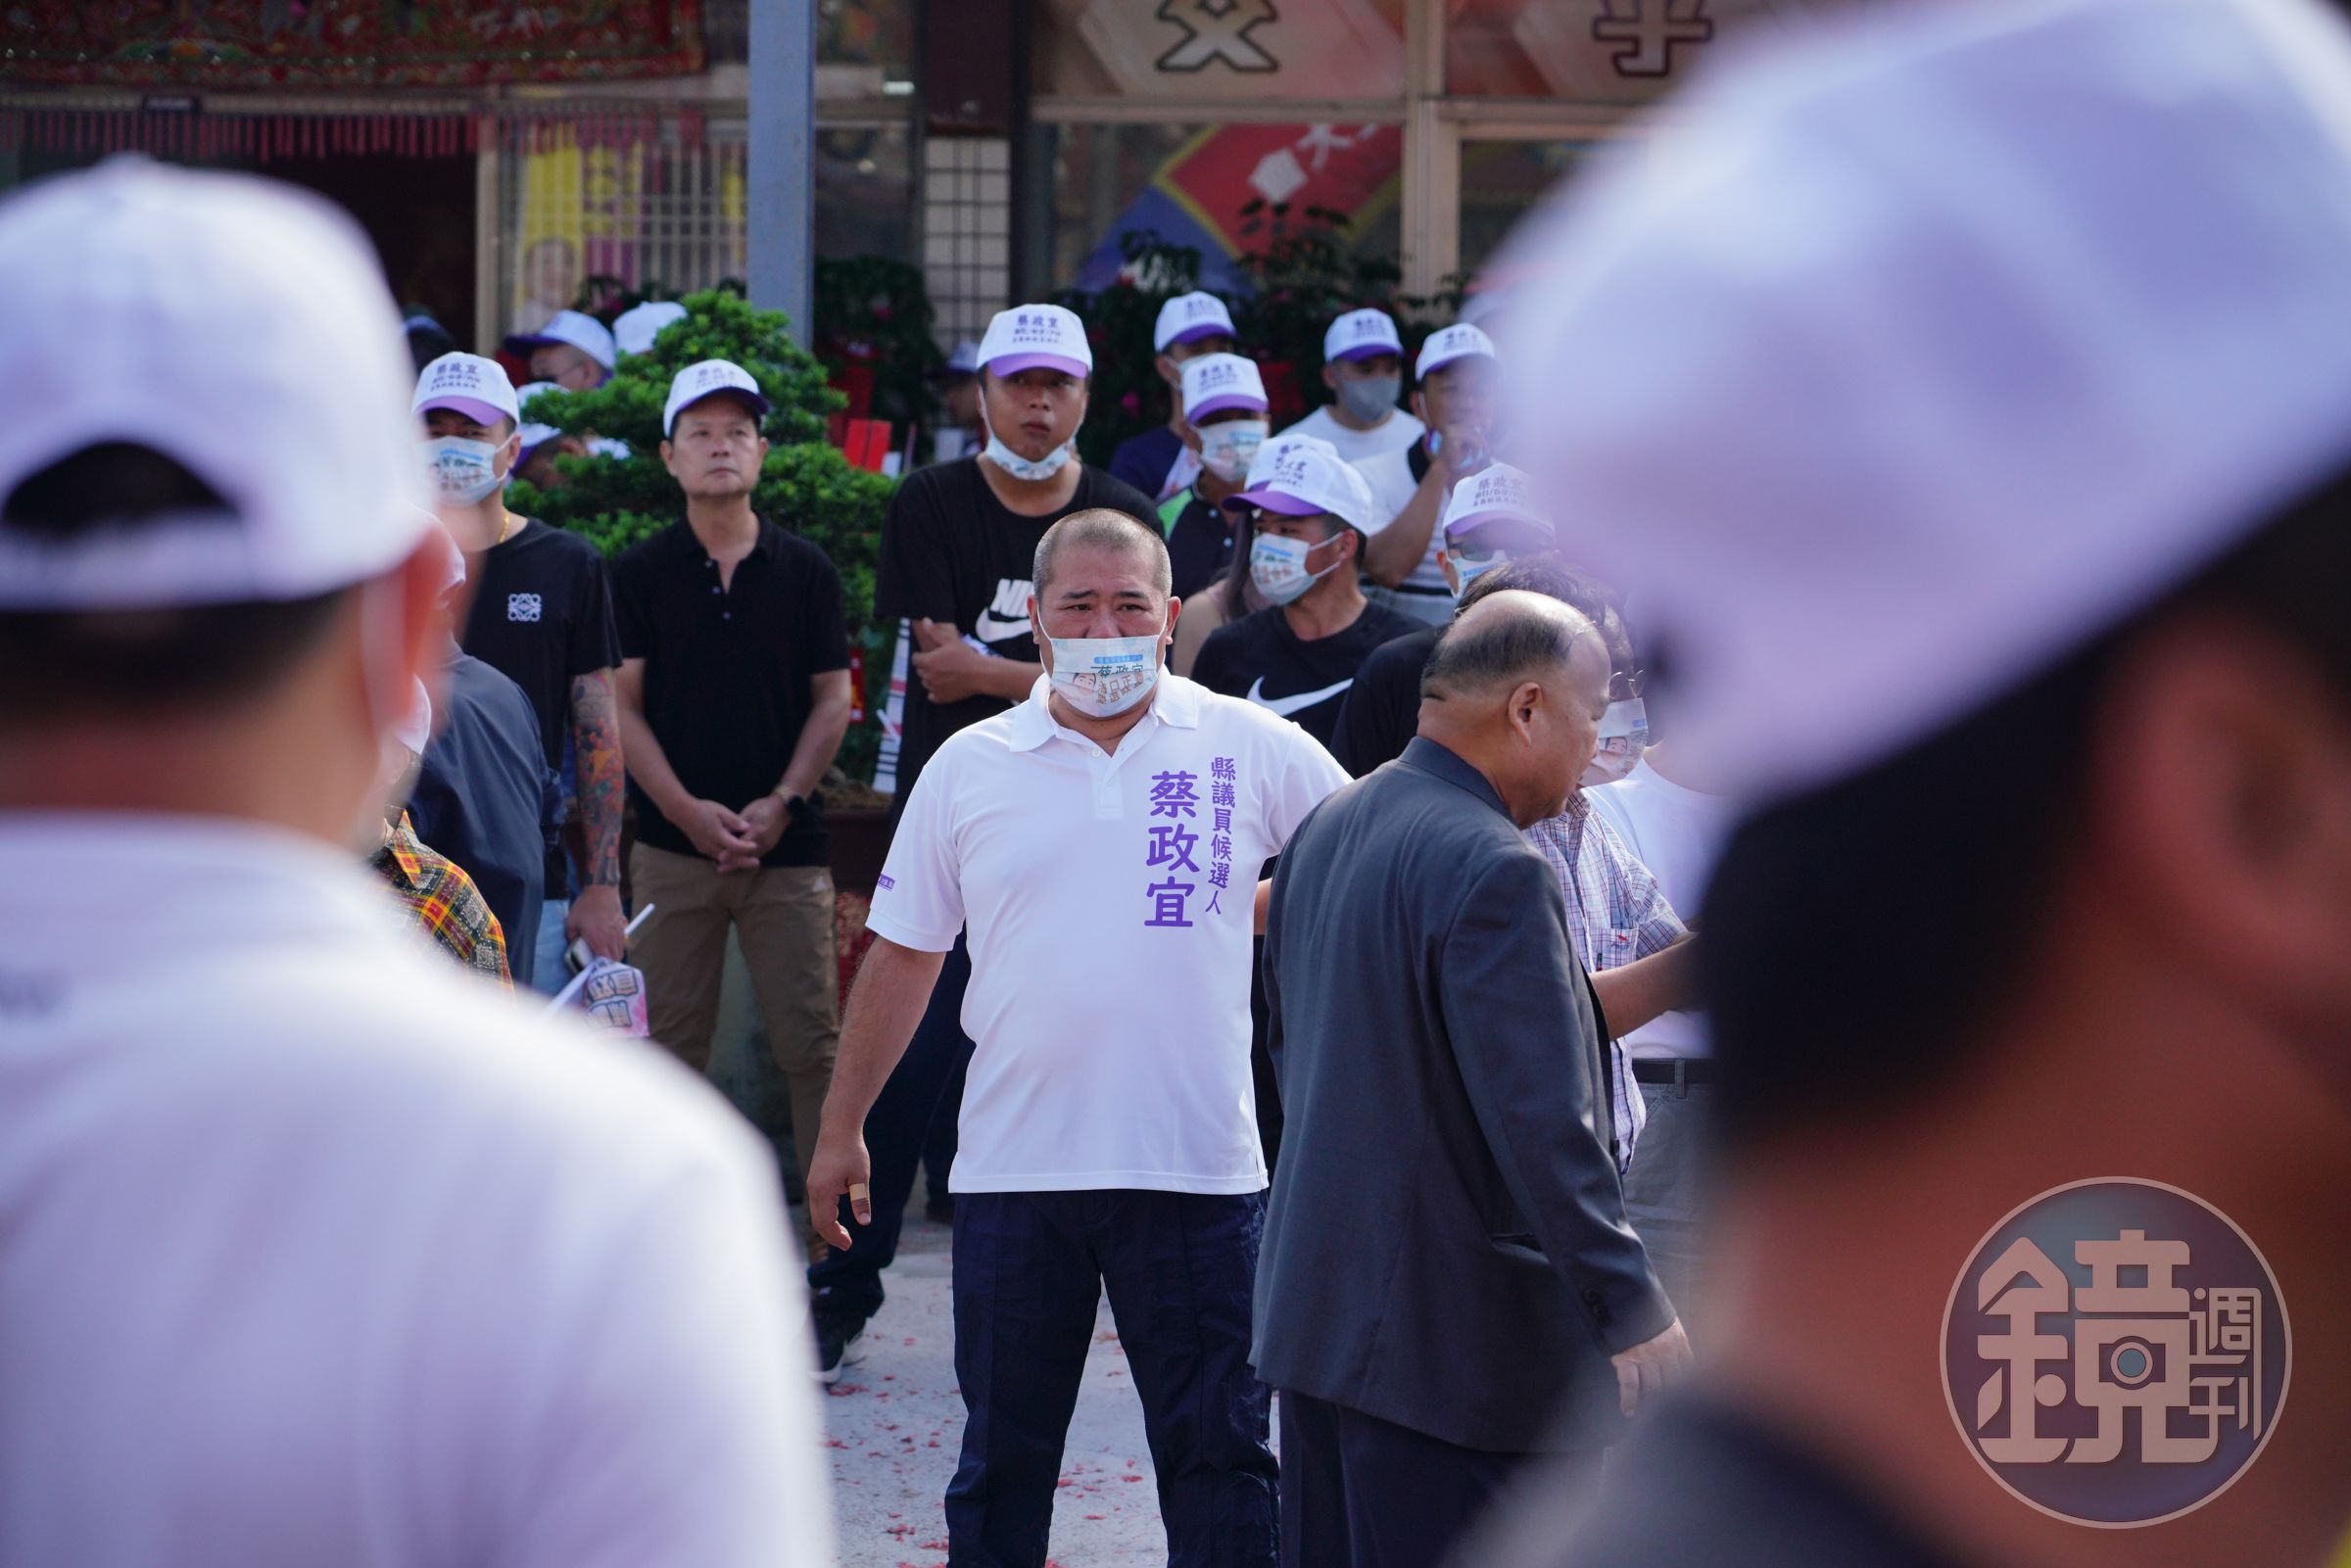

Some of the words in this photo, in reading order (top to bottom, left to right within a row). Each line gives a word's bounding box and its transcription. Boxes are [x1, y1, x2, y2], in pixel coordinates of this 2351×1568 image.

[1144, 771, 1200, 927] 蔡政宜
[1205, 757, 1236, 915] 縣議員候選人
